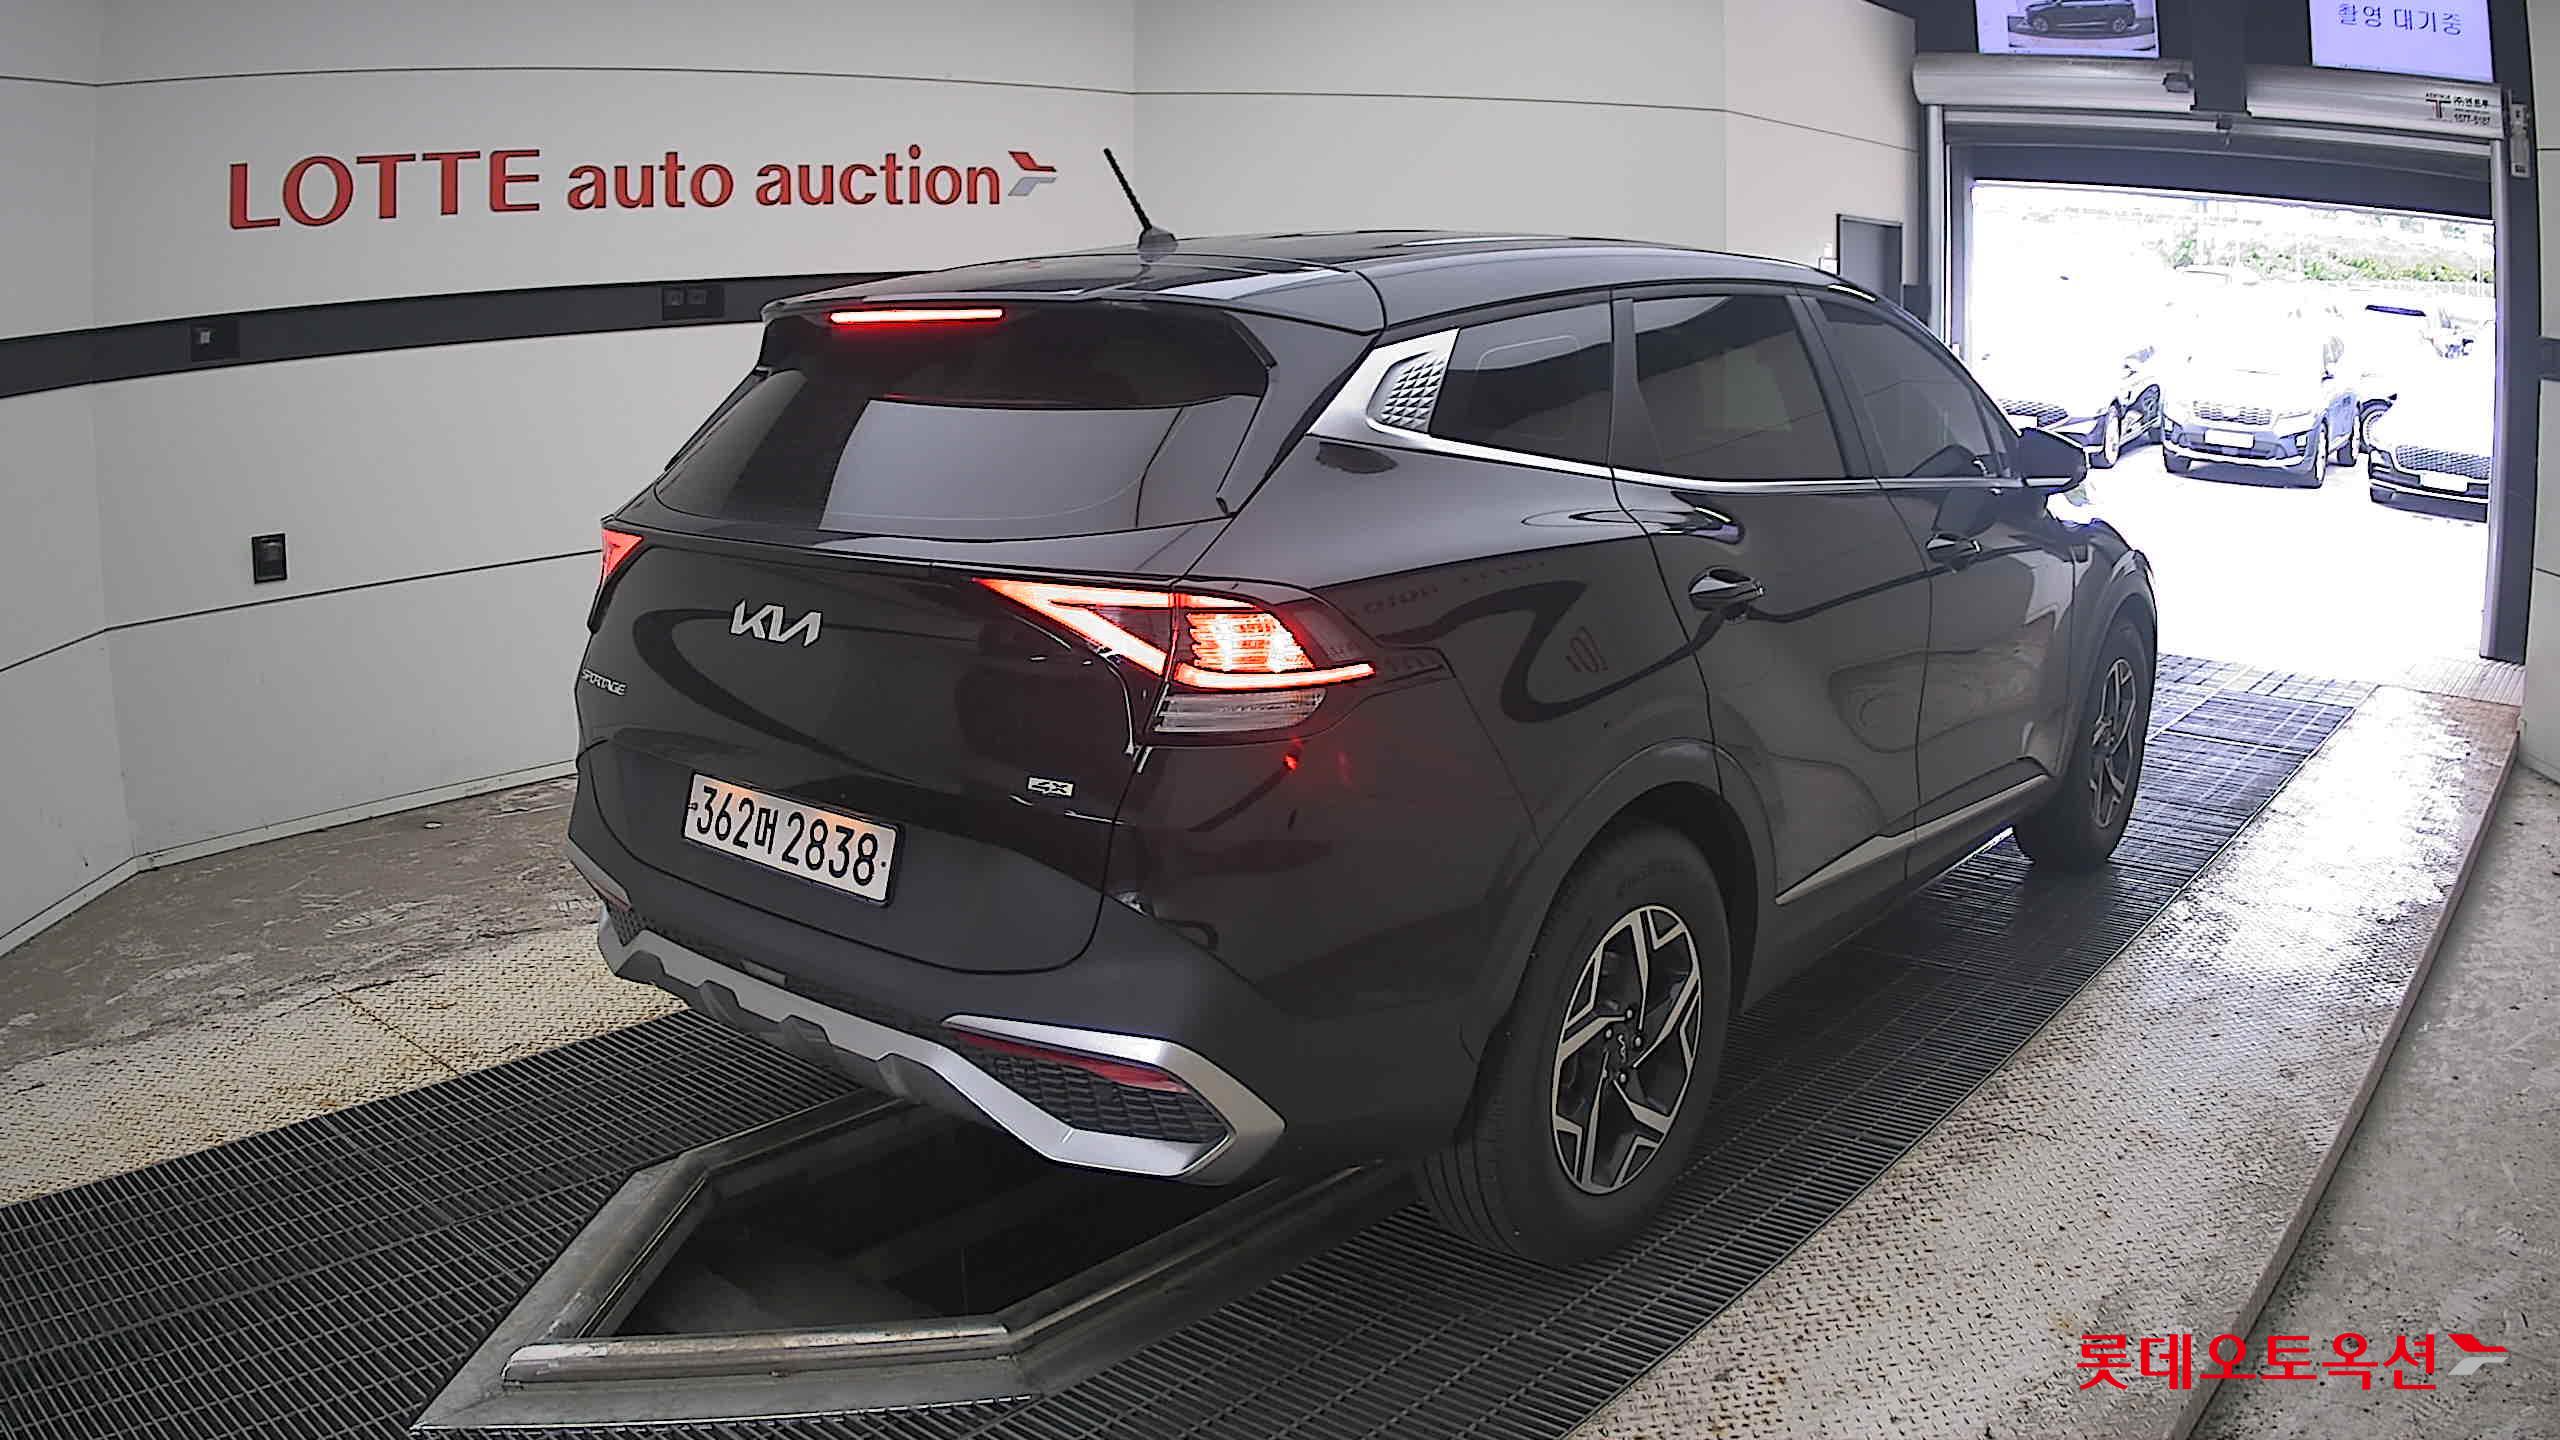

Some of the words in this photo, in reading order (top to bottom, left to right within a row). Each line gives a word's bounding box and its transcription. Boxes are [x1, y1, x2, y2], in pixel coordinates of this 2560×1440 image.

[2393, 8, 2463, 36] 대기중
[231, 150, 541, 230] LOTTE
[567, 152, 735, 210] auto
[756, 145, 1003, 206] auction
[730, 600, 822, 647] KIA
